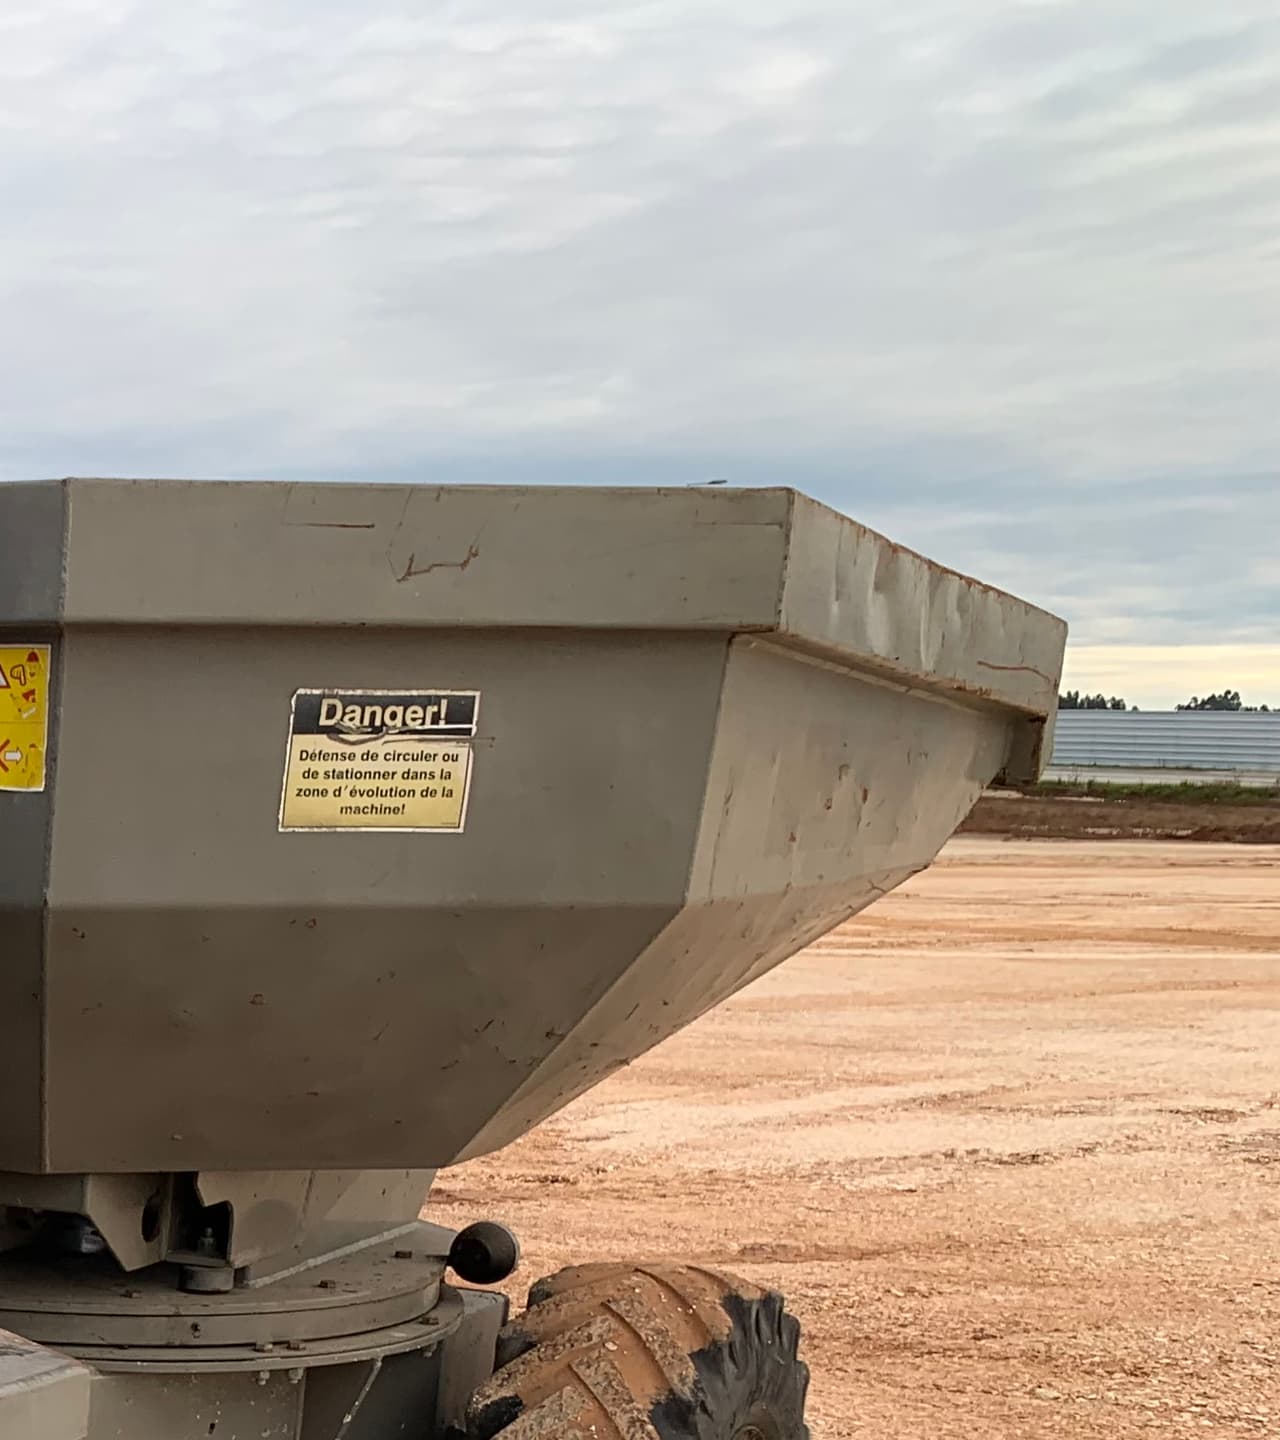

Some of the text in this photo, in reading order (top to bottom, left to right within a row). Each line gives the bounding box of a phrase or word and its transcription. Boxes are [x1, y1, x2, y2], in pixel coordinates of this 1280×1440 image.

[319, 698, 448, 733] Danger!
[299, 748, 459, 762] Défense de circuler ou
[302, 768, 452, 780] de stationner dans la
[296, 787, 329, 798] zone
[420, 786, 437, 798] de
[441, 786, 454, 798] la
[339, 803, 406, 816] machine!
